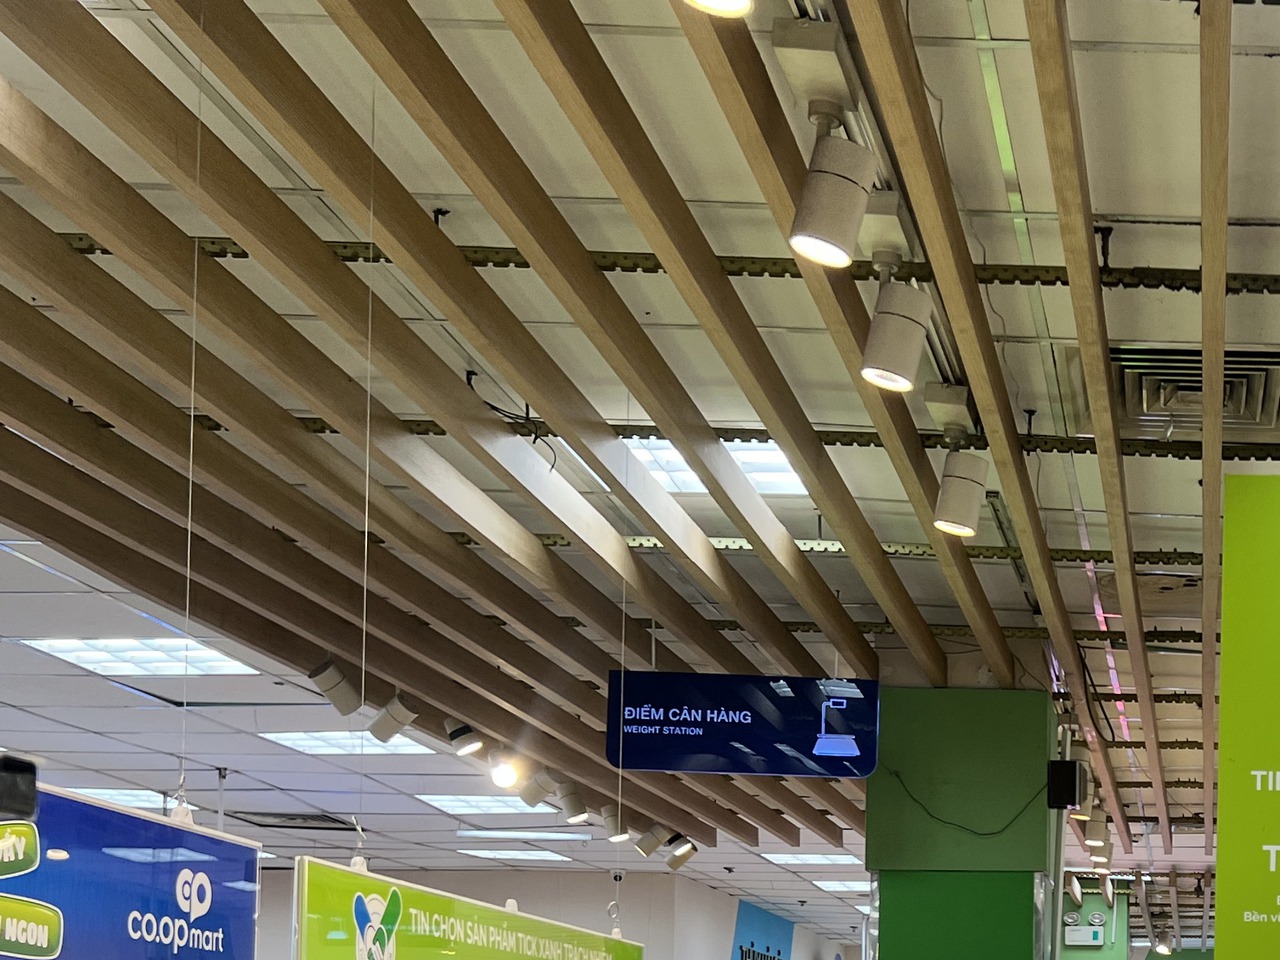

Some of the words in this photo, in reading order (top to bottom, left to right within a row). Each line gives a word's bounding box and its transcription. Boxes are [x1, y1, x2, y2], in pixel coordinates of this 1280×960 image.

[624, 704, 664, 720] ĐIỂM
[669, 706, 702, 721] CÂN
[706, 708, 752, 723] HÀNG
[624, 725, 660, 734] WEIGHT
[663, 726, 703, 736] STATION
[1244, 911, 1267, 922] Bền
[5, 918, 48, 948] NGON
[409, 908, 429, 936] TIN
[432, 914, 464, 947] CHỌN
[467, 916, 488, 948] SẢN
[489, 921, 516, 953] PHẨM
[518, 932, 538, 956] TICK
